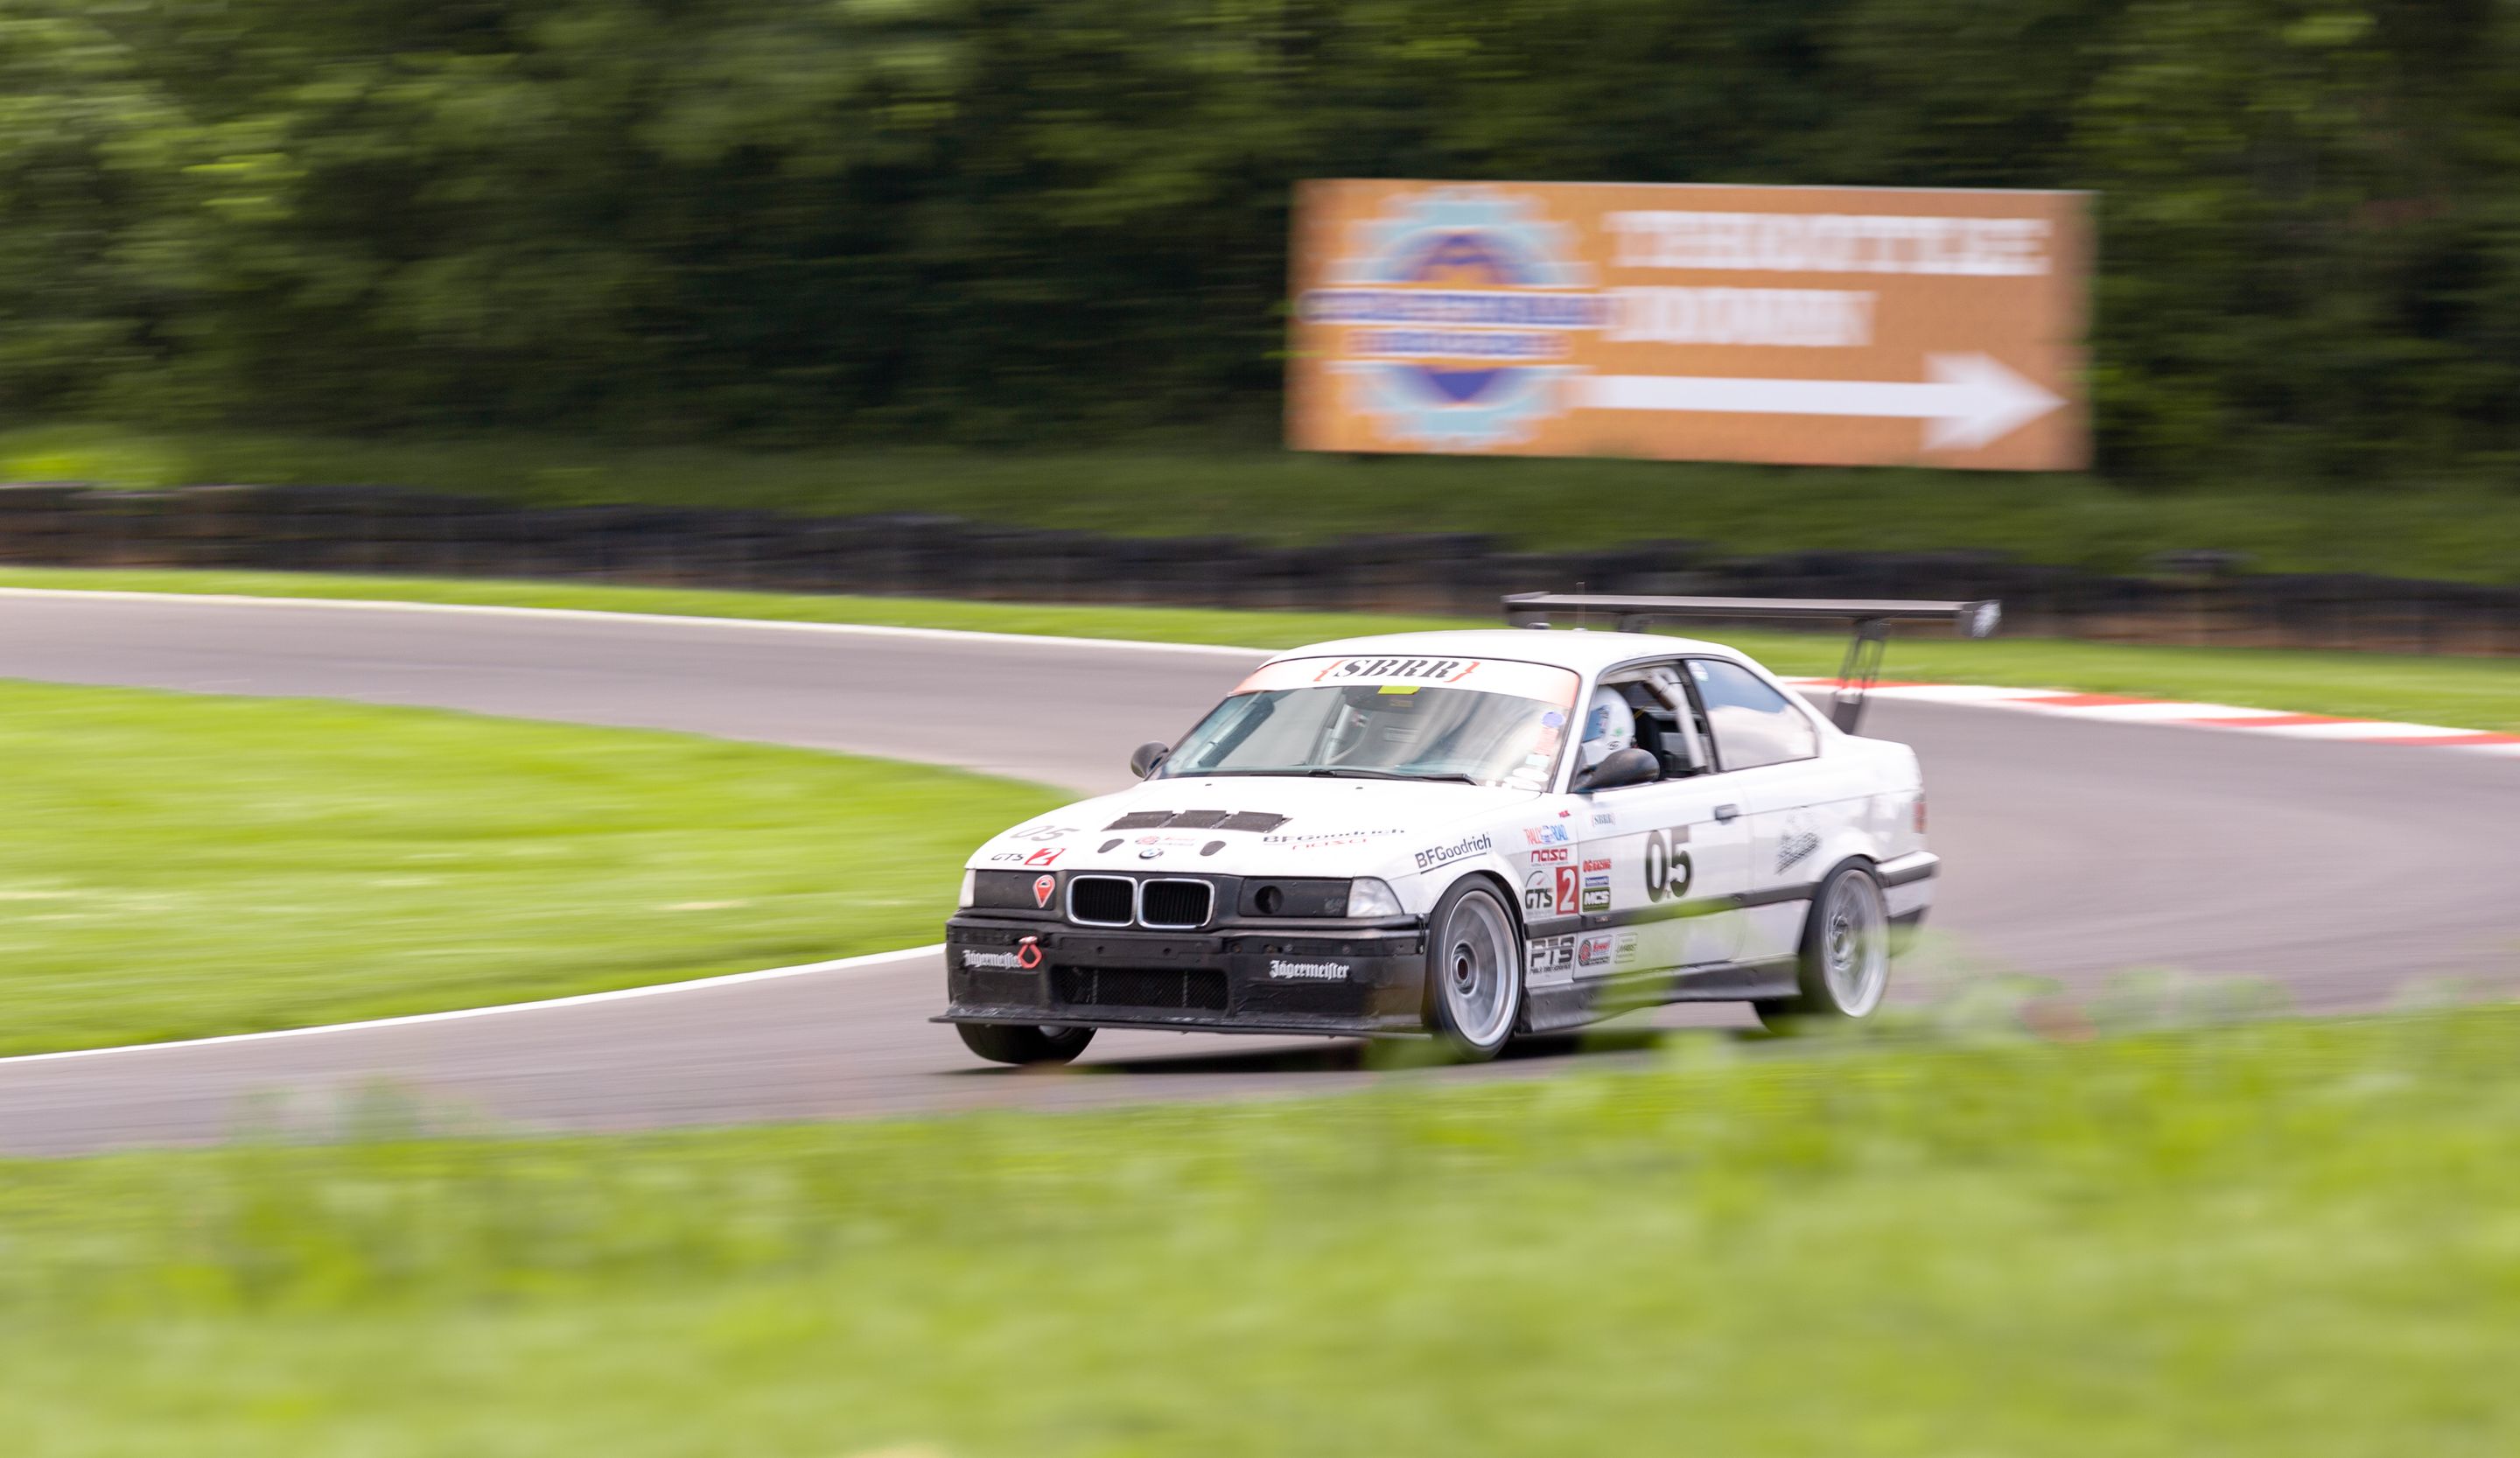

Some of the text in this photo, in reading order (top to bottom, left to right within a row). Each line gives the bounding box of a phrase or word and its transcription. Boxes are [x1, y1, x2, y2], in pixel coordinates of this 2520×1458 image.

[1010, 825, 1081, 842] 05
[990, 847, 1066, 866] GTS 2
[1414, 833, 1492, 869] BFGoodrich
[1531, 848, 1568, 862] nasa
[1646, 824, 1694, 903] 05
[1525, 868, 1576, 912] GTS 2
[1584, 889, 1610, 906] MCS
[1530, 936, 1574, 967] PTS
[1269, 959, 1350, 981] Jägermeister
